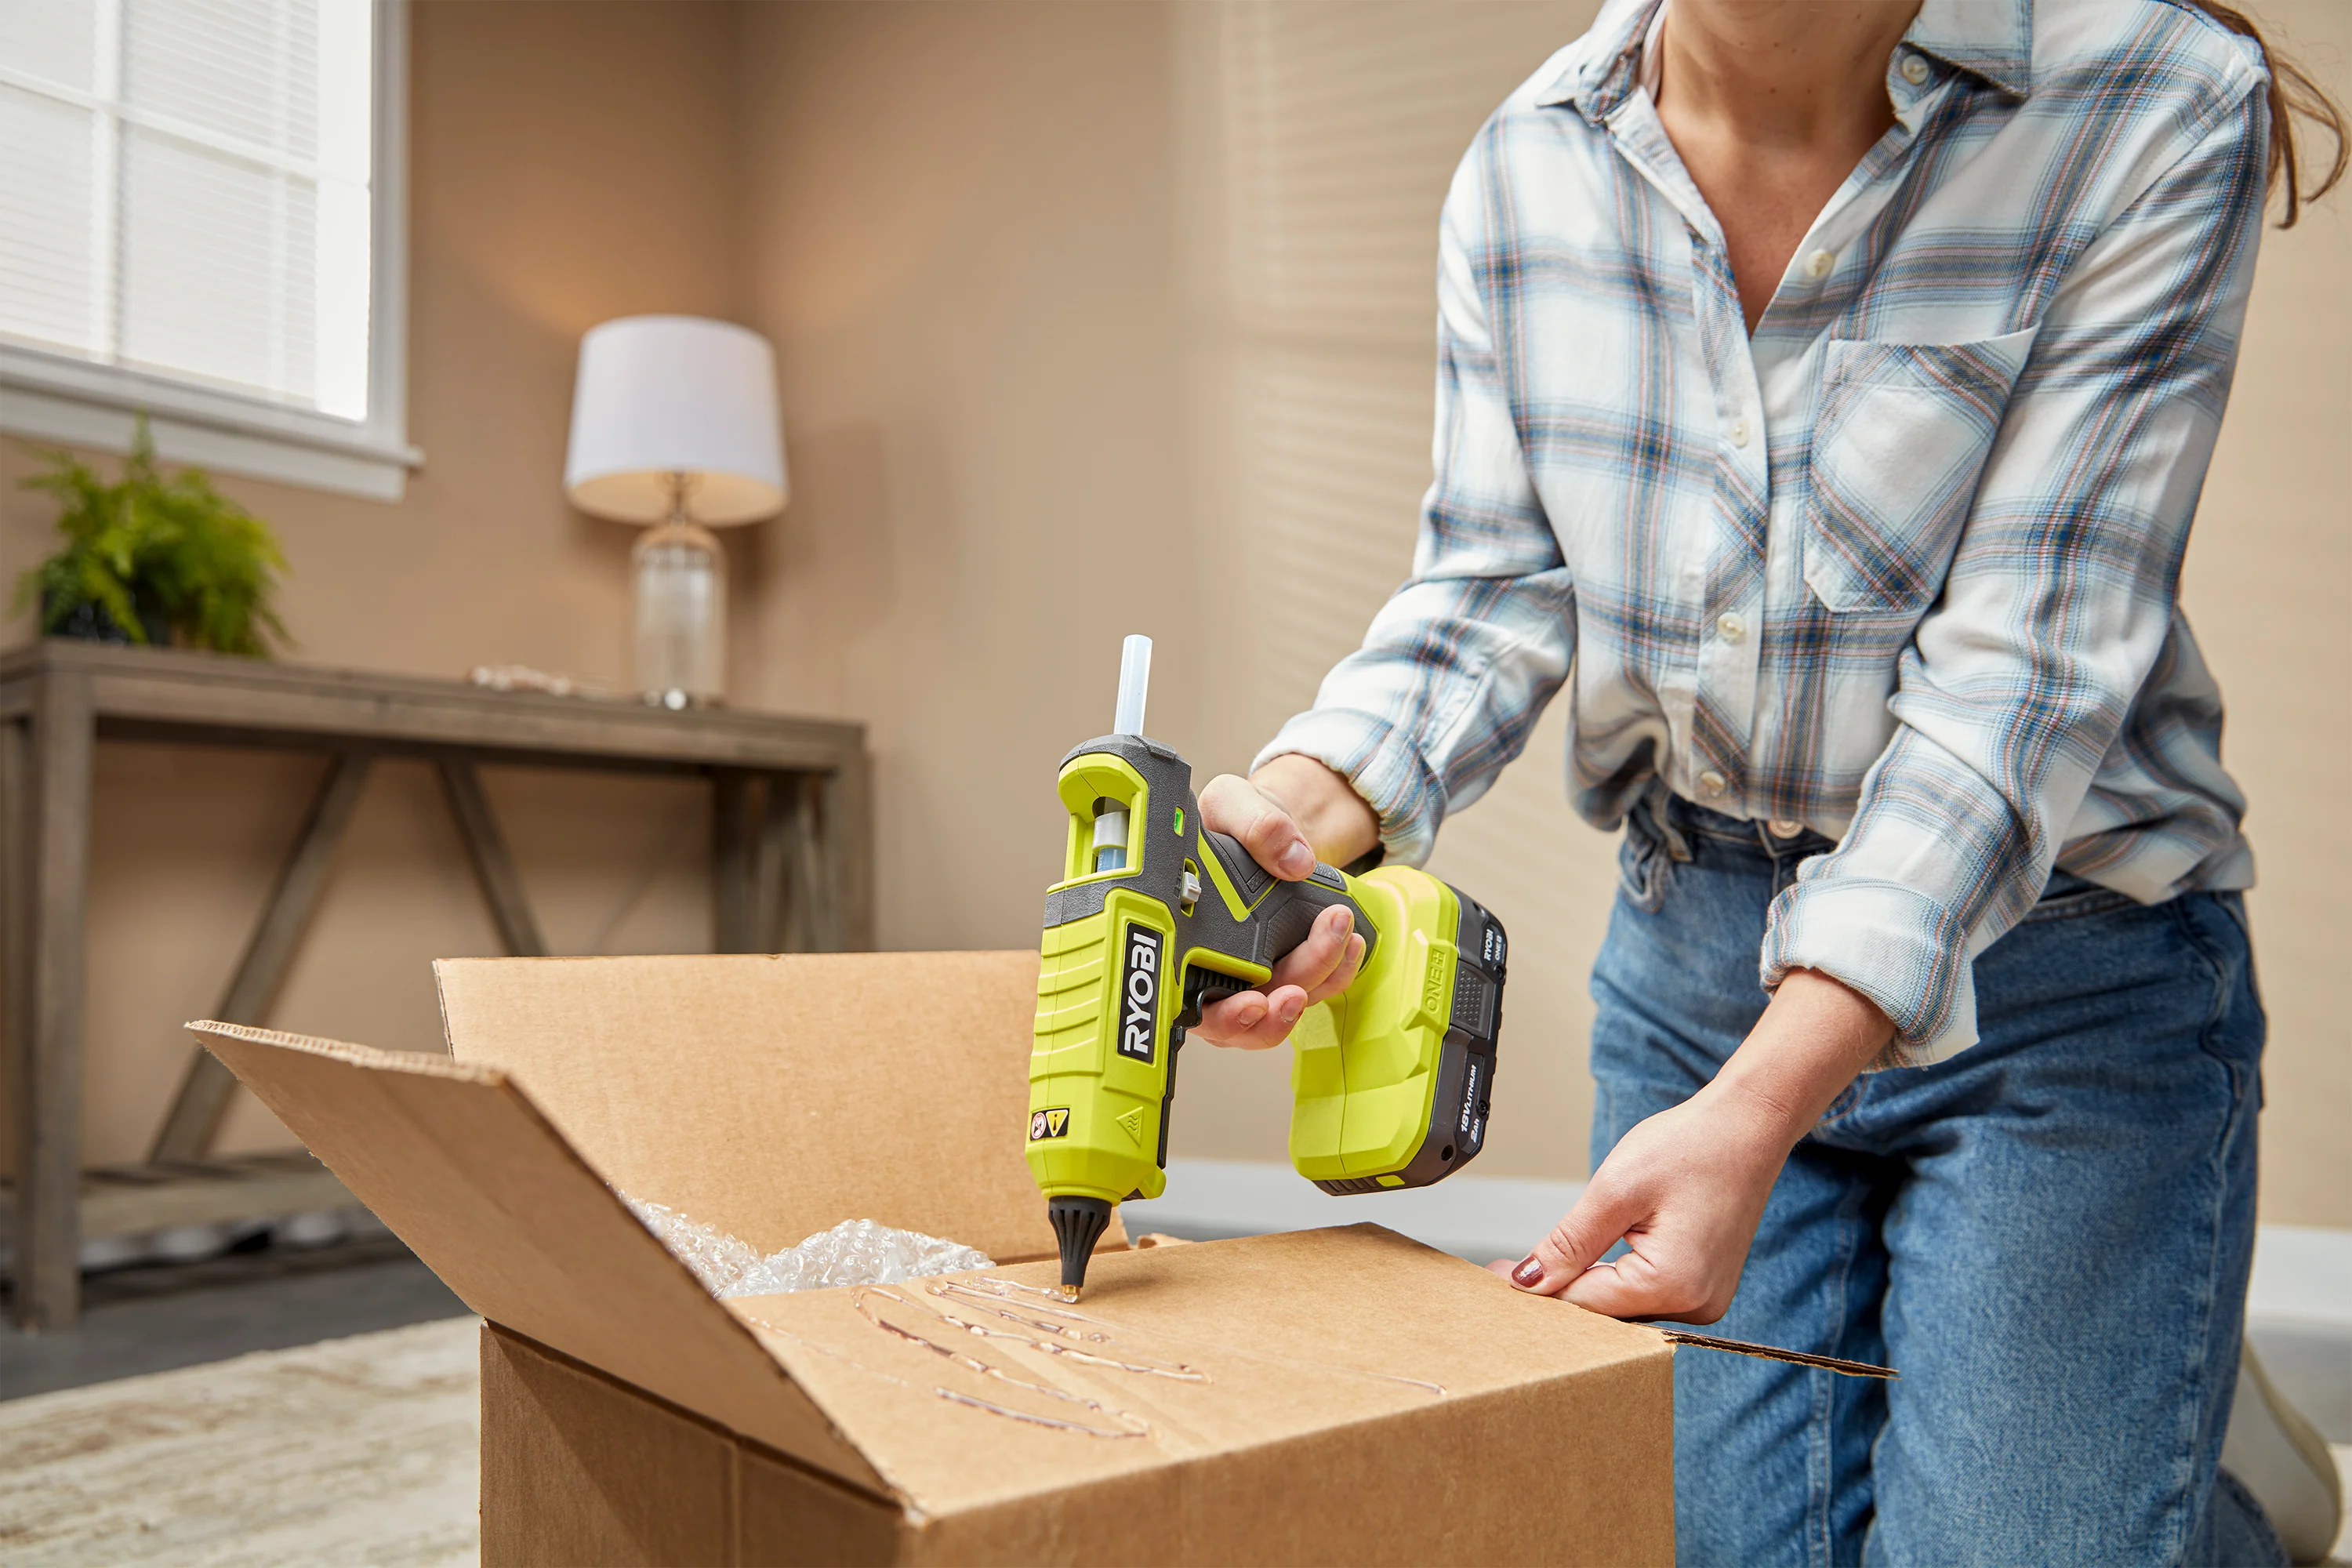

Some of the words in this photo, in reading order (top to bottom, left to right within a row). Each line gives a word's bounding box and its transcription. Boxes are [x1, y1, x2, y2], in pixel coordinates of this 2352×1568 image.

[1483, 928, 1494, 961] RYOBI
[1123, 932, 1157, 1054] RYOBI
[1470, 1118, 1480, 1143] 2Ah
